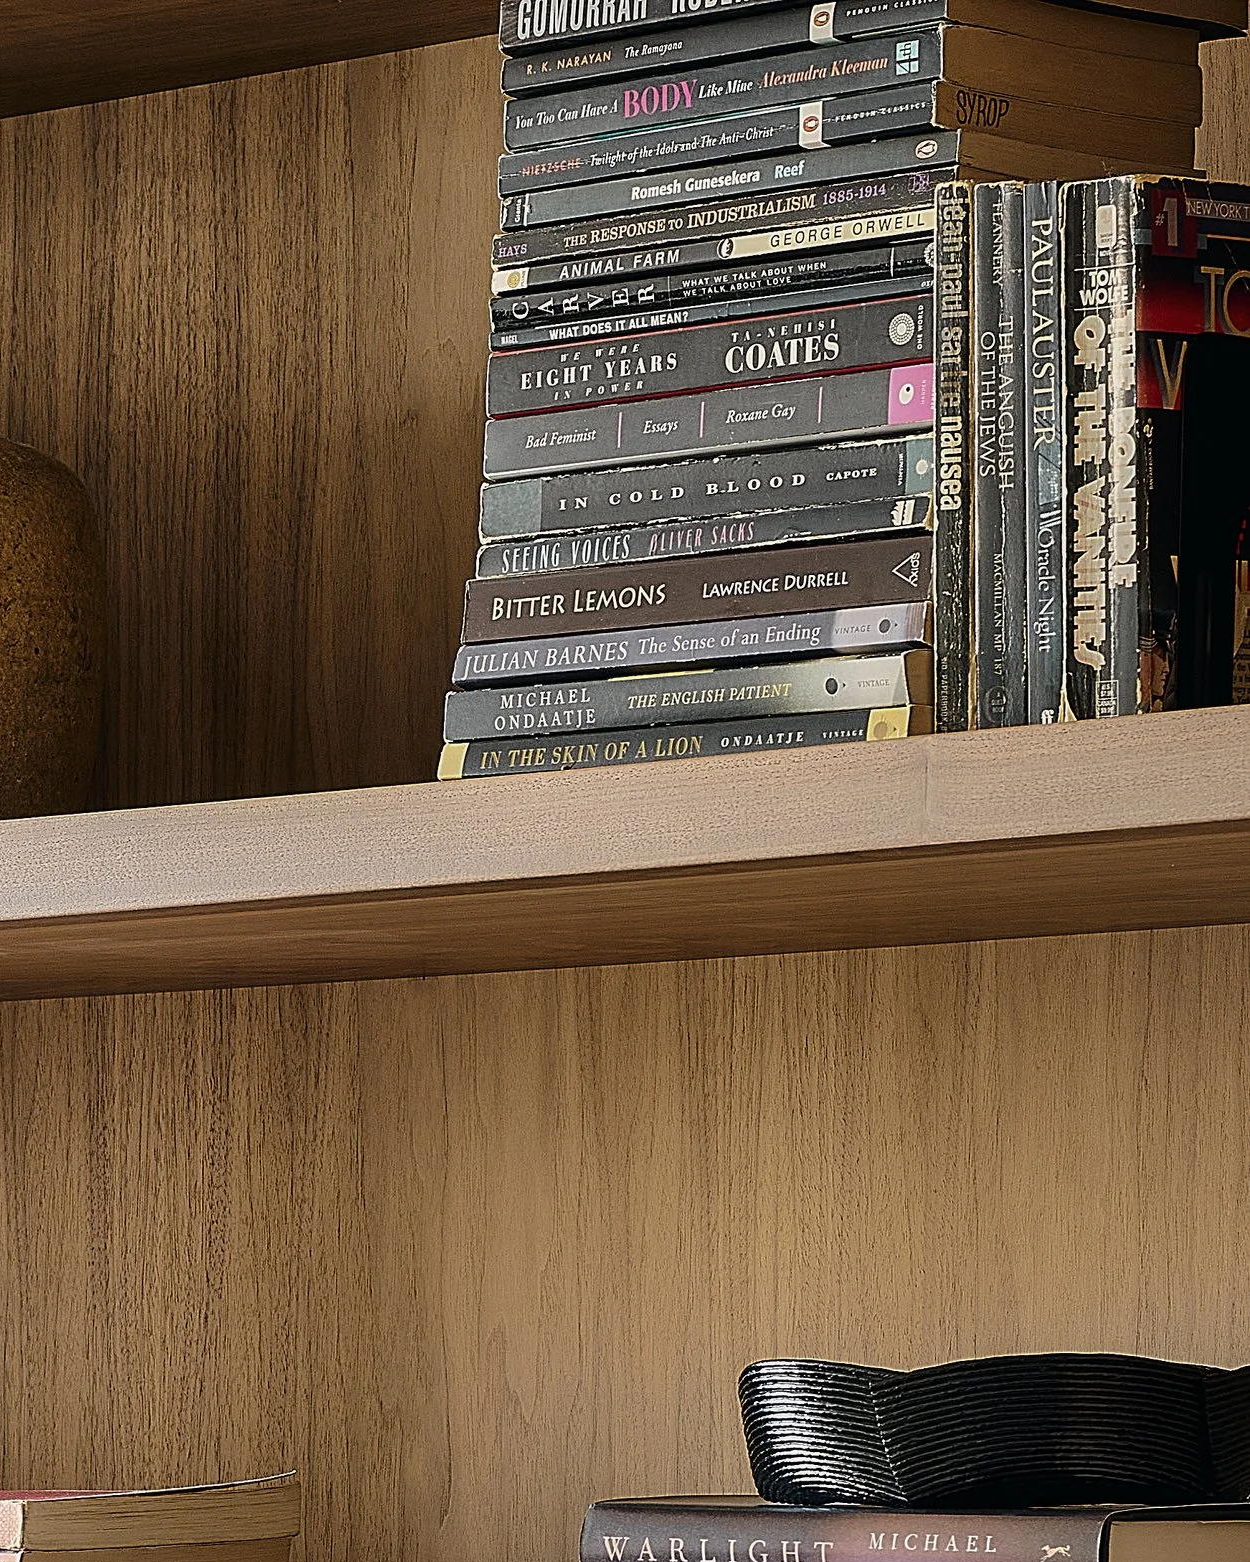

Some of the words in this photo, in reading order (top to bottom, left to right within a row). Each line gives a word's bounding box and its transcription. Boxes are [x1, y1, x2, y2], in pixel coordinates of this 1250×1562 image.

[624, 46, 642, 58] The
[647, 40, 682, 55] Ramayana
[515, 114, 533, 129] You
[536, 112, 554, 126] Too
[558, 107, 578, 121] Can
[581, 102, 608, 117] Have
[609, 100, 618, 113] A
[623, 79, 697, 117] BODY
[698, 83, 722, 99] Like
[725, 79, 752, 94] Mine
[759, 66, 827, 89] Alexandra
[831, 55, 888, 73] Kleeman
[631, 178, 682, 200] Romesh
[685, 167, 760, 193] Gunesekera
[775, 161, 804, 179] Reef
[770, 226, 842, 247] GEORGE
[852, 213, 926, 237] ORWELL
[560, 257, 625, 279] ANIMAL
[633, 249, 680, 271] FARM
[724, 333, 841, 374] COATES
[520, 365, 593, 391] EIGHT
[605, 352, 678, 379] YEARS
[643, 418, 678, 435] Essays
[726, 409, 768, 425] Roxane
[771, 404, 795, 420] Gay
[525, 433, 547, 449] Bad
[550, 428, 596, 446] Feminist
[825, 467, 878, 482] CAPOTE
[559, 496, 588, 511] IN
[609, 485, 685, 506] COLD
[706, 473, 806, 496] BLOOD
[702, 577, 779, 600] LAWRENCE
[784, 570, 849, 592] DURRELL
[491, 591, 565, 621] BITTER
[573, 584, 666, 612] LEMONS
[638, 637, 668, 657] The
[671, 632, 717, 653] Sense
[720, 632, 738, 648] of
[740, 630, 762, 645] an
[765, 624, 822, 646] Ending
[462, 650, 537, 679] JULIAN
[544, 641, 629, 667] BARNES
[868, 1532, 998, 1553] MICHAEL
